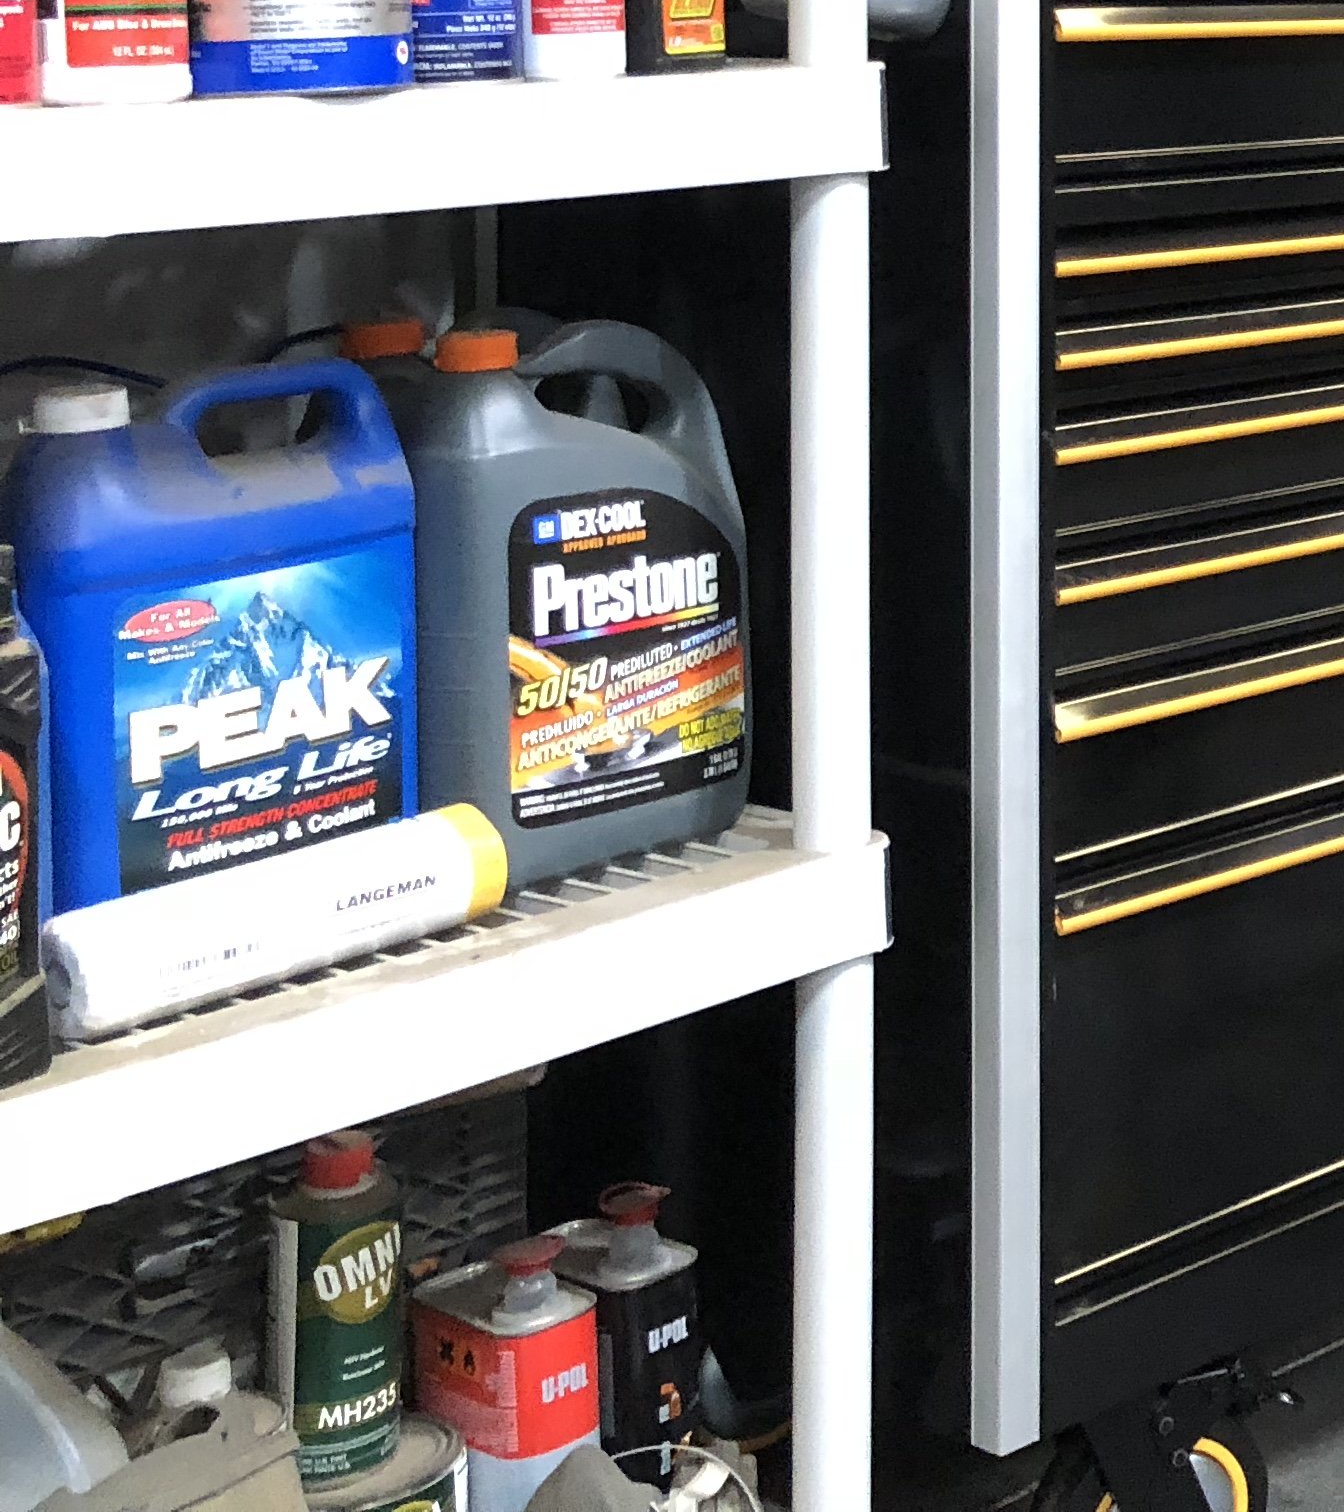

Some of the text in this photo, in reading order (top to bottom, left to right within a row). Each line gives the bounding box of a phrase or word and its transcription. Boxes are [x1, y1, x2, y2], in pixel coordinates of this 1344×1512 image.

[533, 552, 719, 637] Prestone
[516, 656, 608, 717] 50/50
[610, 642, 673, 681] PREDILUTED
[603, 628, 739, 704] ANTIFREEZE/COOLANT
[128, 654, 393, 788] PEAK
[520, 710, 594, 749] PREDILUIDO
[131, 734, 392, 822] Long Life
[167, 778, 379, 848] FULL STRENGTH CONCENTRATE
[167, 798, 376, 872] Antifreeze & Coolant
[335, 874, 437, 912] LANGEMAN
[312, 1221, 401, 1303] OMNI
[363, 1266, 393, 1310] LV
[647, 1315, 690, 1354] U-POL
[317, 1381, 397, 1430] MH235
[541, 1362, 589, 1404] U-POL
